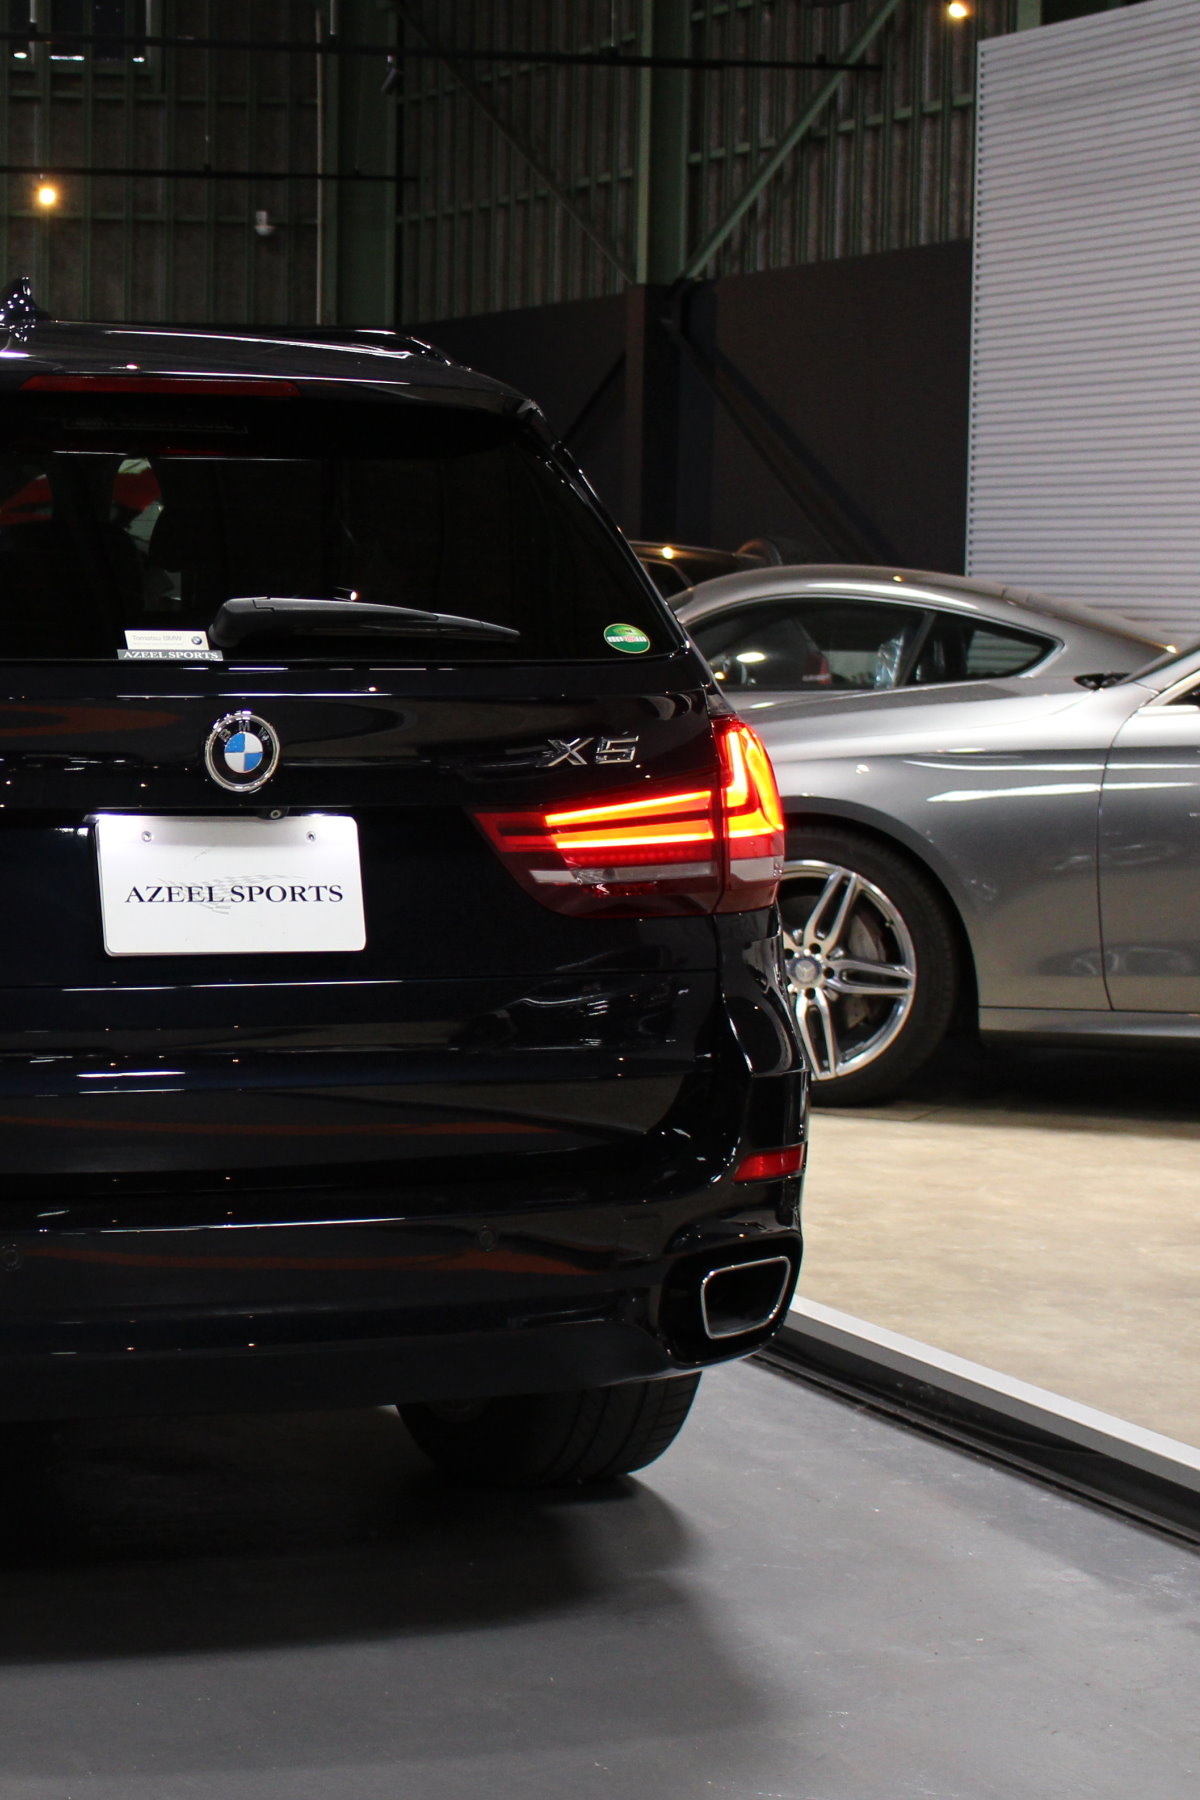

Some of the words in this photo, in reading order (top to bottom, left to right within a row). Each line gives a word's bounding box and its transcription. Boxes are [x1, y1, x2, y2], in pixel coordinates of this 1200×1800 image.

[123, 651, 167, 659] AZEEL
[168, 651, 218, 660] SPORTS
[537, 735, 640, 767] X5
[125, 885, 225, 904] AZEEL
[230, 884, 344, 903] SPORTS
